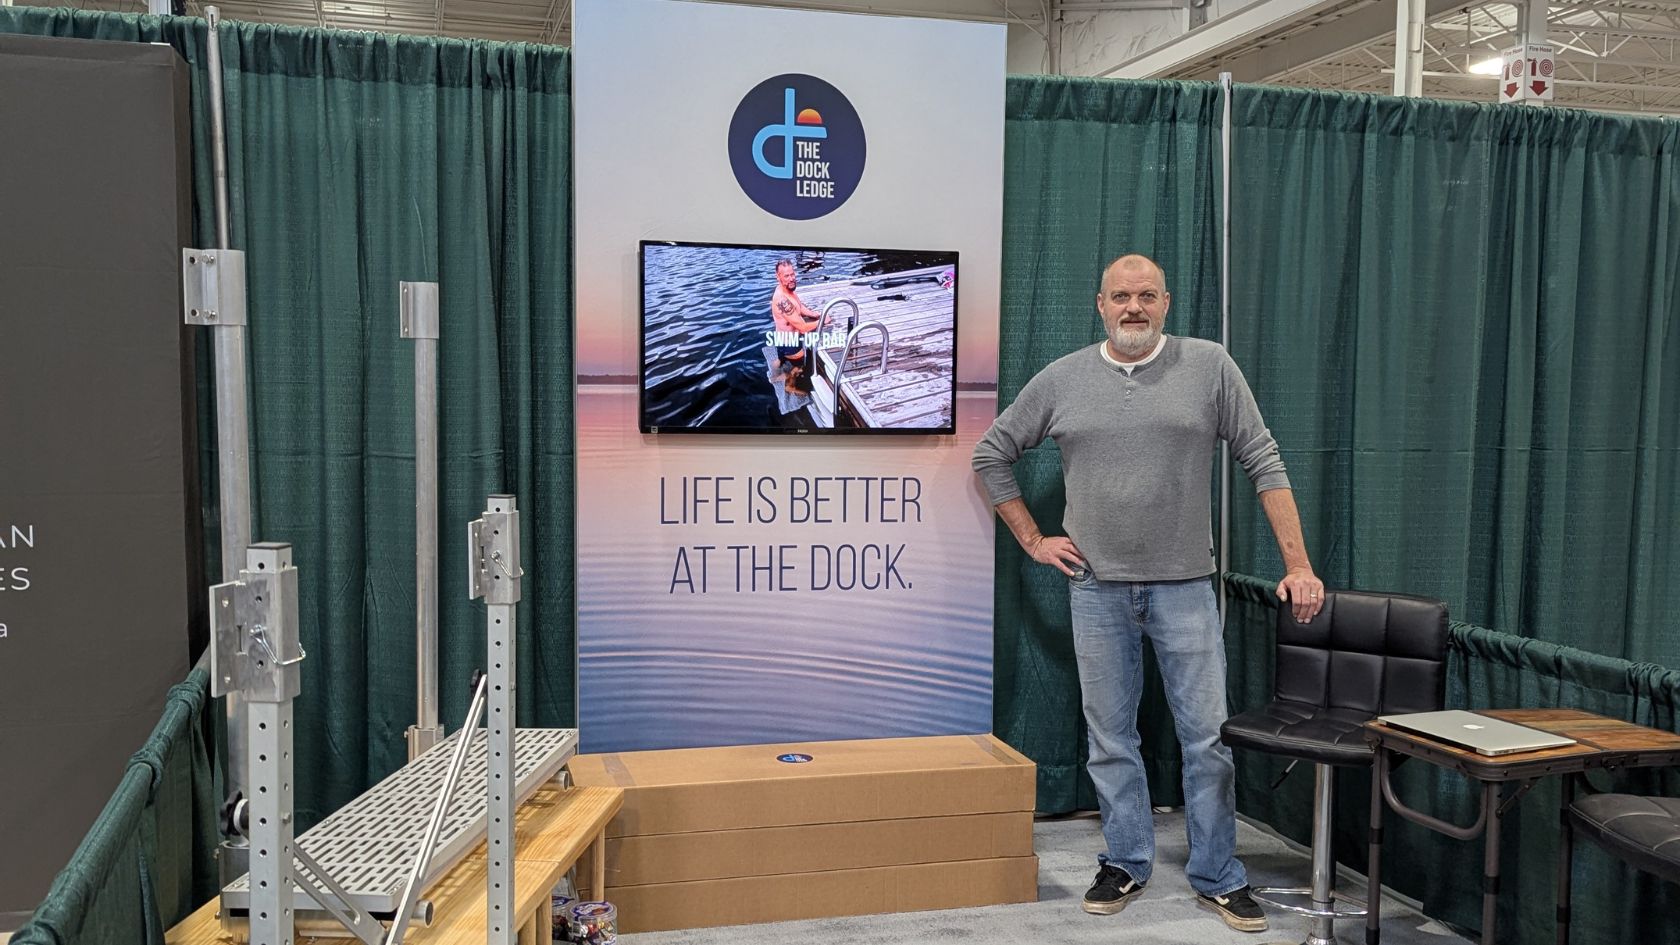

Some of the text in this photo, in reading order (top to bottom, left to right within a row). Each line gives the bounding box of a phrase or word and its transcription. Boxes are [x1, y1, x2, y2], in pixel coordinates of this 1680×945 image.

[796, 141, 820, 159] THE
[796, 161, 830, 179] DOCK
[796, 180, 835, 198] LEDGE
[765, 331, 820, 348] SWIM-UP
[660, 476, 922, 525] LIFE IS BETTER
[669, 543, 913, 594] AT THE DOCK.
